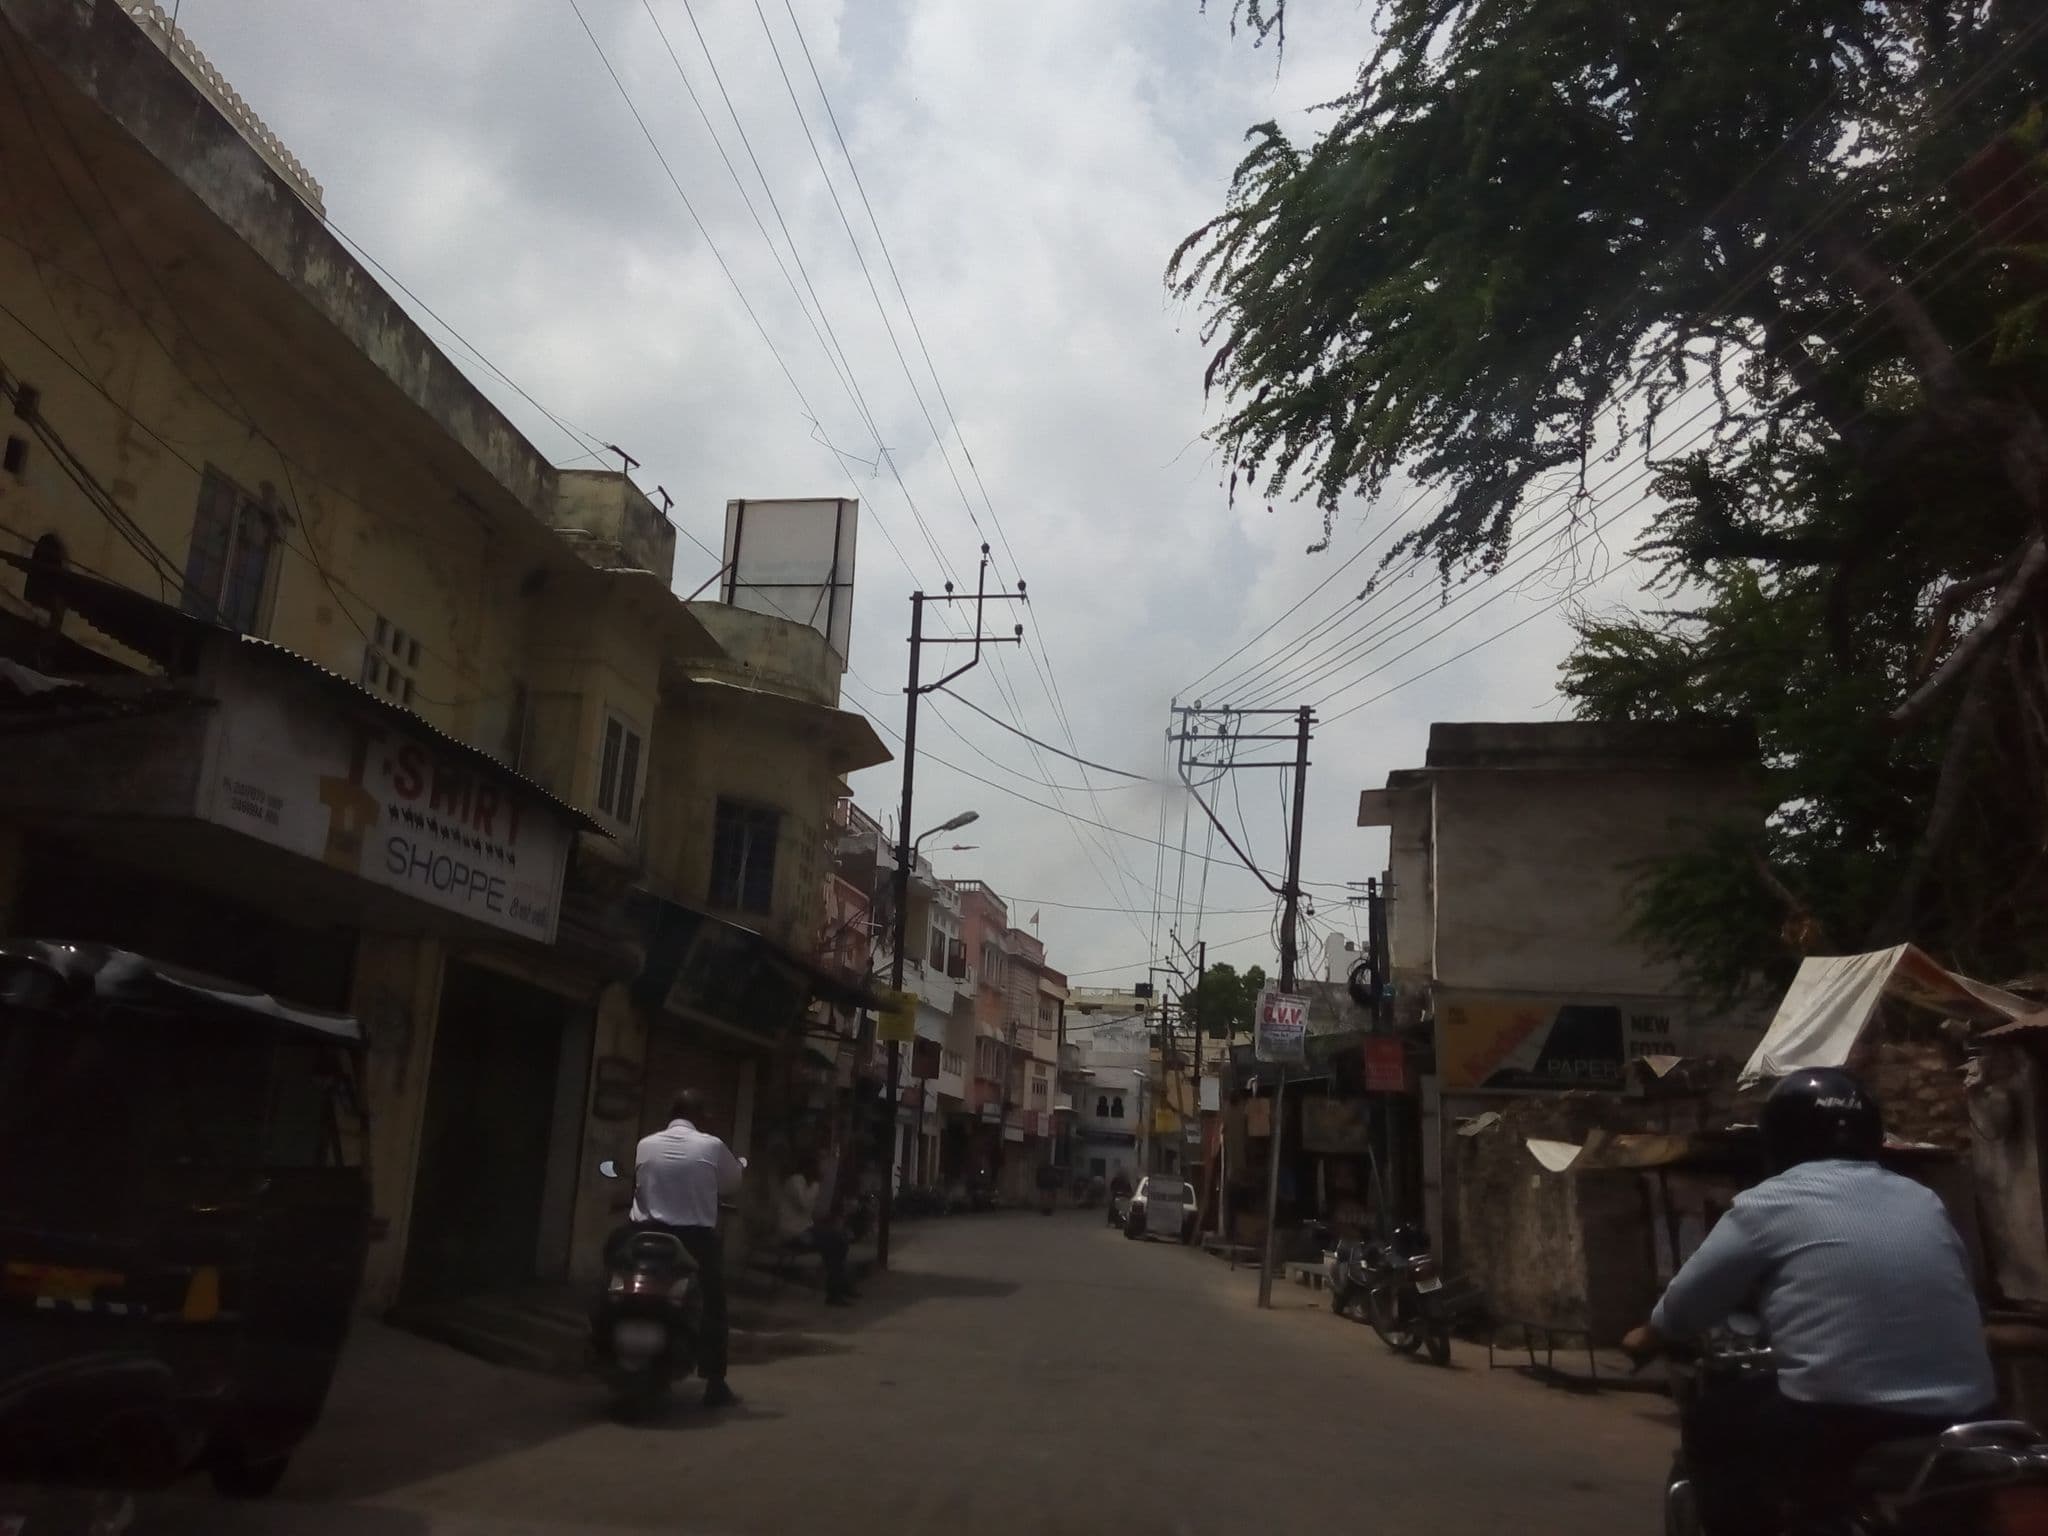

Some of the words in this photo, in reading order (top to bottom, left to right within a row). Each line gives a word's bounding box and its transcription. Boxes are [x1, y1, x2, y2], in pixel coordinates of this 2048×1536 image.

[387, 836, 506, 913] SHOPPE
[1630, 1015, 1670, 1034] NEW
[1546, 1057, 1617, 1079] PAPER
